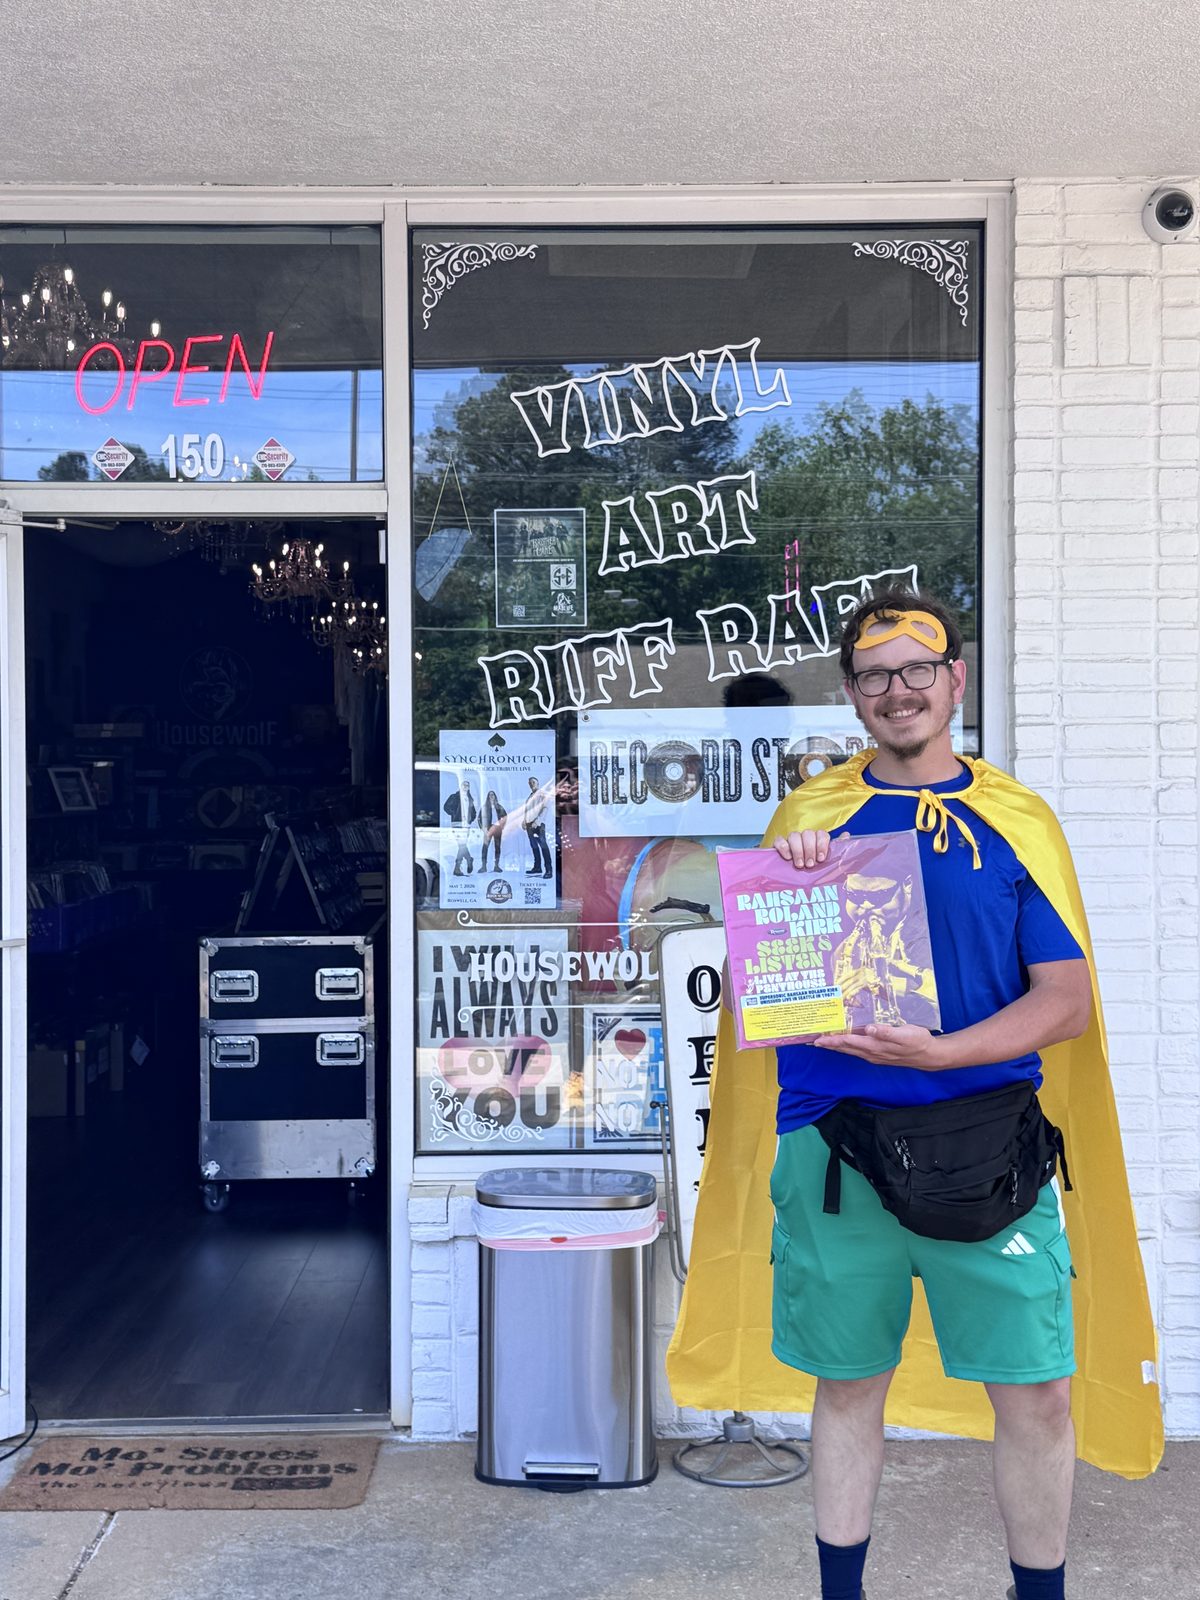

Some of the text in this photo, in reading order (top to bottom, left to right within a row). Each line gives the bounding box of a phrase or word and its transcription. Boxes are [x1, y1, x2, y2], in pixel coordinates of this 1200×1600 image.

[75, 331, 275, 416] OPEN
[509, 337, 792, 459] VINYL
[160, 433, 225, 479] 150
[598, 469, 759, 577] ART
[478, 617, 676, 728] RIFF
[444, 754, 553, 766] SYNCHRONICITY
[737, 885, 839, 911] RAHSAAN
[755, 901, 841, 926] ROLAND
[789, 916, 843, 938] KIRK
[432, 945, 443, 973] I
[756, 935, 816, 957] SEEK
[469, 950, 659, 983] HOUSEWOL
[744, 951, 824, 975] LISTEN
[754, 973, 783, 985] LIVE
[785, 971, 799, 983] AT
[430, 976, 559, 1039] ALWAYS
[443, 1048, 546, 1076] LOVE
[431, 1086, 561, 1131] YOU
[178, 1446, 319, 1461] Shoes
[128, 1461, 358, 1477] Problems
